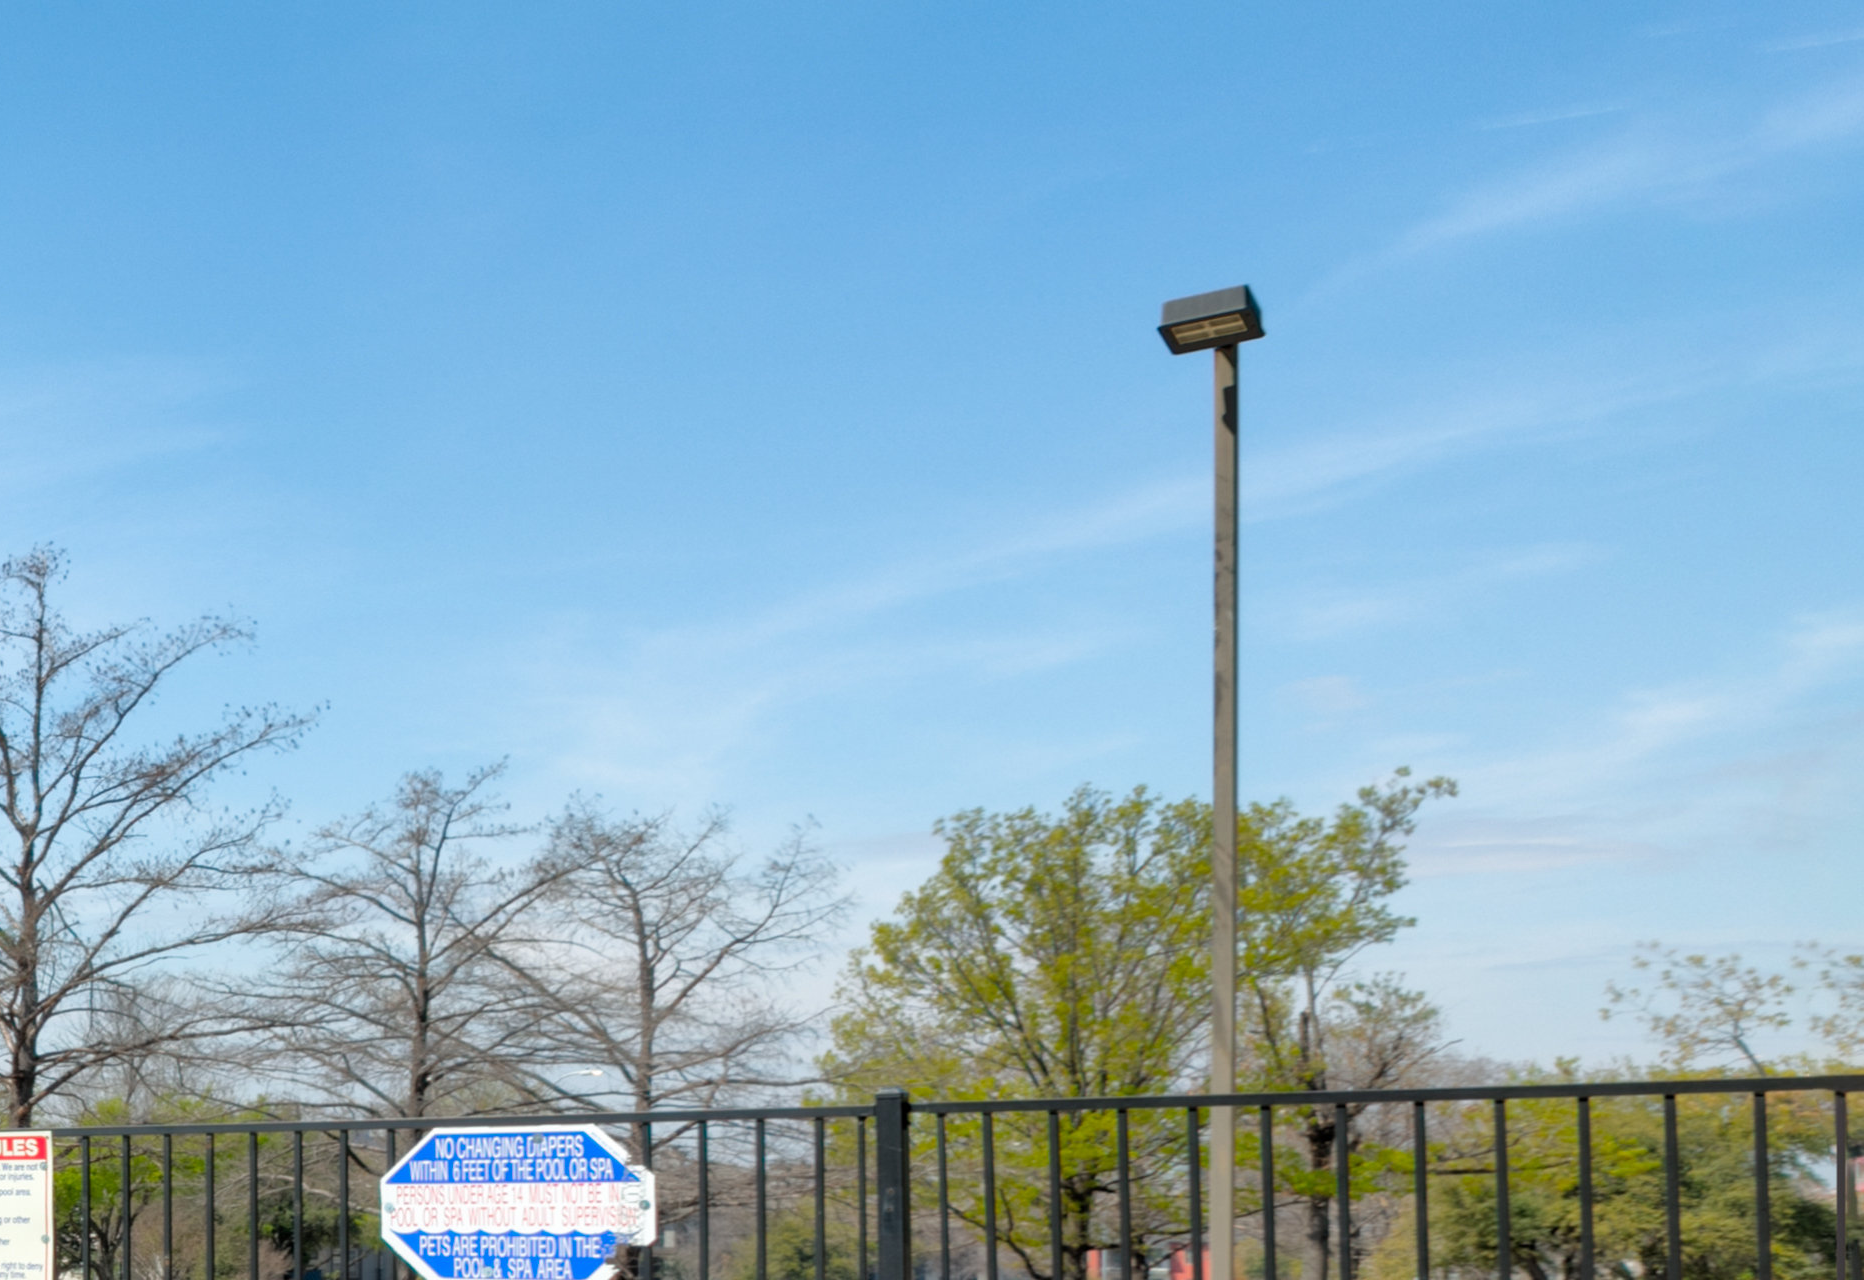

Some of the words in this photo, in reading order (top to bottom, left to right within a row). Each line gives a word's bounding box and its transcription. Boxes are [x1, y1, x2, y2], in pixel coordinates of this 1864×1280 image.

[435, 1137, 455, 1159] NO
[456, 1136, 524, 1159] CHANGING
[527, 1135, 584, 1158] DIAPERS
[409, 1160, 448, 1181] WITHIN
[453, 1160, 461, 1181] 6
[462, 1160, 491, 1181] FEET
[492, 1160, 509, 1181] OF
[510, 1159, 534, 1181] THE
[535, 1158, 568, 1180] POOL
[569, 1158, 588, 1180] OR
[590, 1158, 614, 1180] SPA
[396, 1185, 446, 1205] PERSONS
[449, 1185, 484, 1205] UNDER
[487, 1184, 508, 1204] AGE
[512, 1184, 523, 1204] 14
[529, 1184, 558, 1204] MUST
[562, 1183, 584, 1204] NOT
[588, 1183, 602, 1203] BE
[609, 1183, 619, 1203] IN
[391, 1207, 418, 1227] POOL
[423, 1207, 438, 1227] OR
[444, 1207, 463, 1227] SPA
[469, 1207, 517, 1227] WITHOUT
[523, 1206, 555, 1226] ADULT
[419, 1235, 451, 1256] PETS
[453, 1235, 478, 1256] ARE
[480, 1236, 556, 1258] PROHIBITED
[558, 1236, 571, 1258] IN
[574, 1236, 602, 1258] THE
[454, 1258, 486, 1278] POOL
[493, 1258, 502, 1278] &
[508, 1258, 533, 1279] SPA
[537, 1258, 572, 1280] AREA
